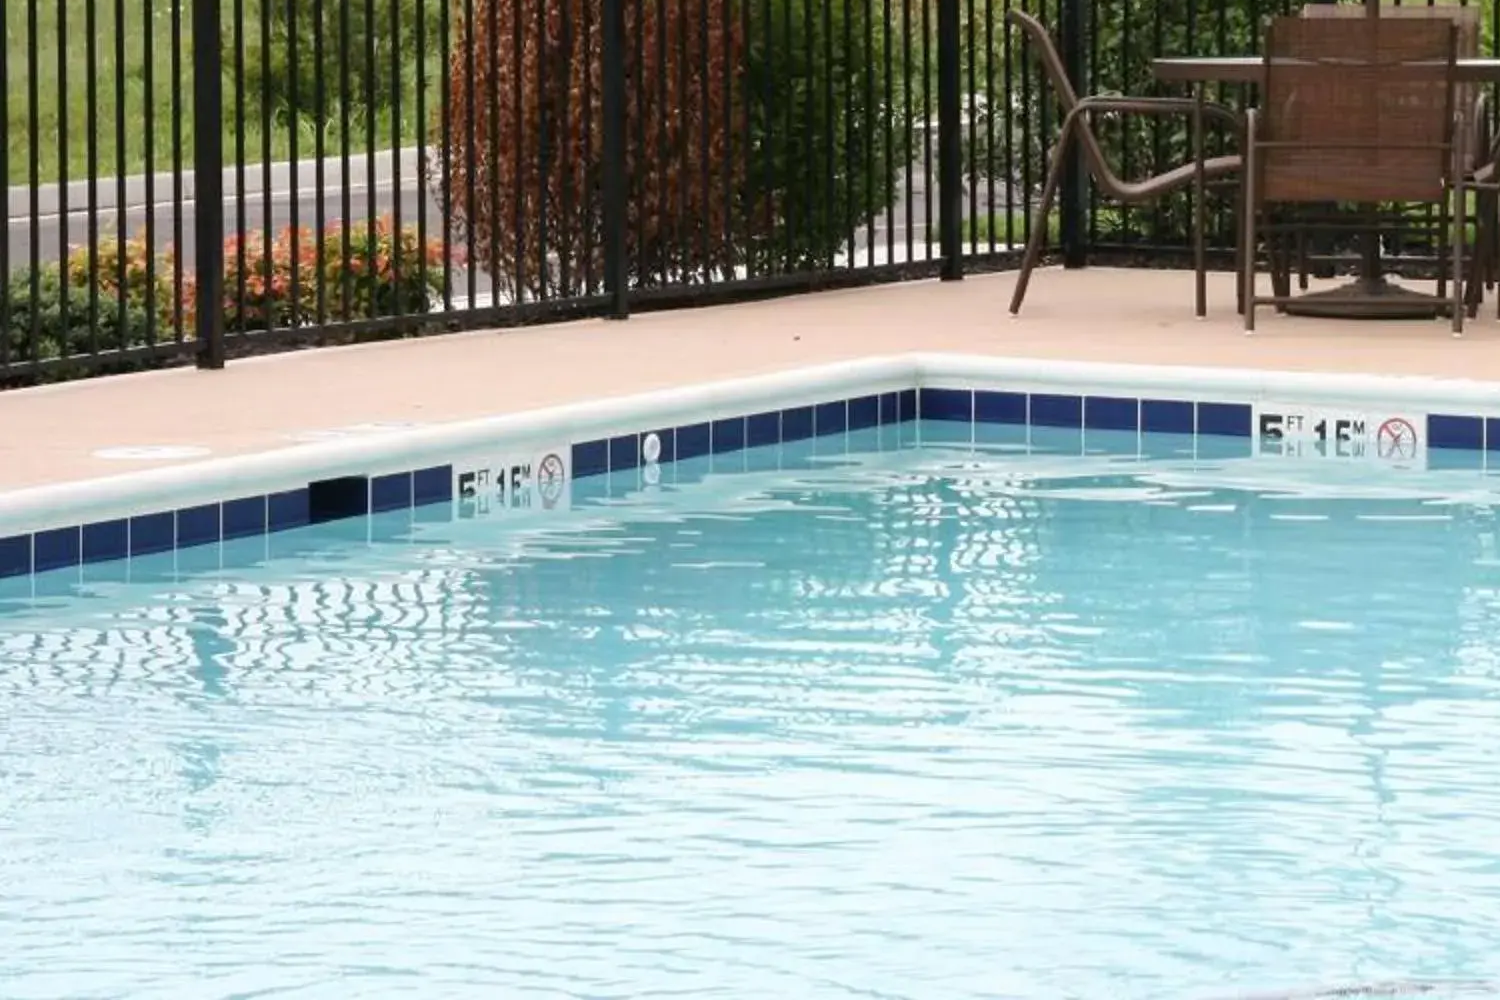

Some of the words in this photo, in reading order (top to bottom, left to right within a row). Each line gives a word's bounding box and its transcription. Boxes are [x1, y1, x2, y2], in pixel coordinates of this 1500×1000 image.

[1287, 415, 1304, 431] FT
[1353, 419, 1365, 434] M
[477, 468, 490, 486] FT
